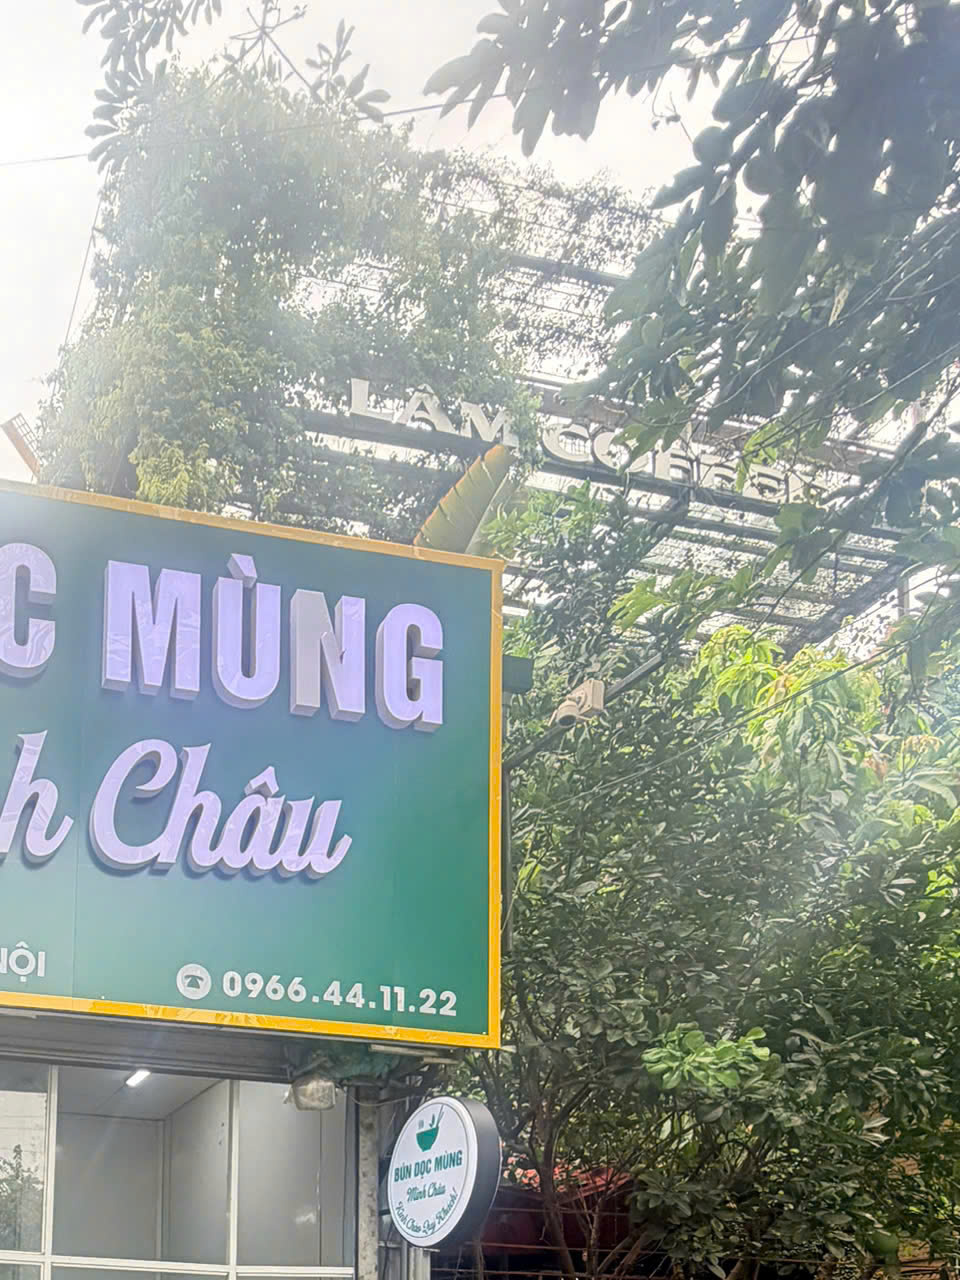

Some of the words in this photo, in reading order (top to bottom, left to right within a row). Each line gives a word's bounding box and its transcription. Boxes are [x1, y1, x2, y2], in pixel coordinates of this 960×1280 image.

[102, 553, 443, 731] MÙNG
[90, 742, 352, 876] Châu
[222, 971, 457, 1016] 0966.44.11.22
[414, 1158, 431, 1179] DỌC
